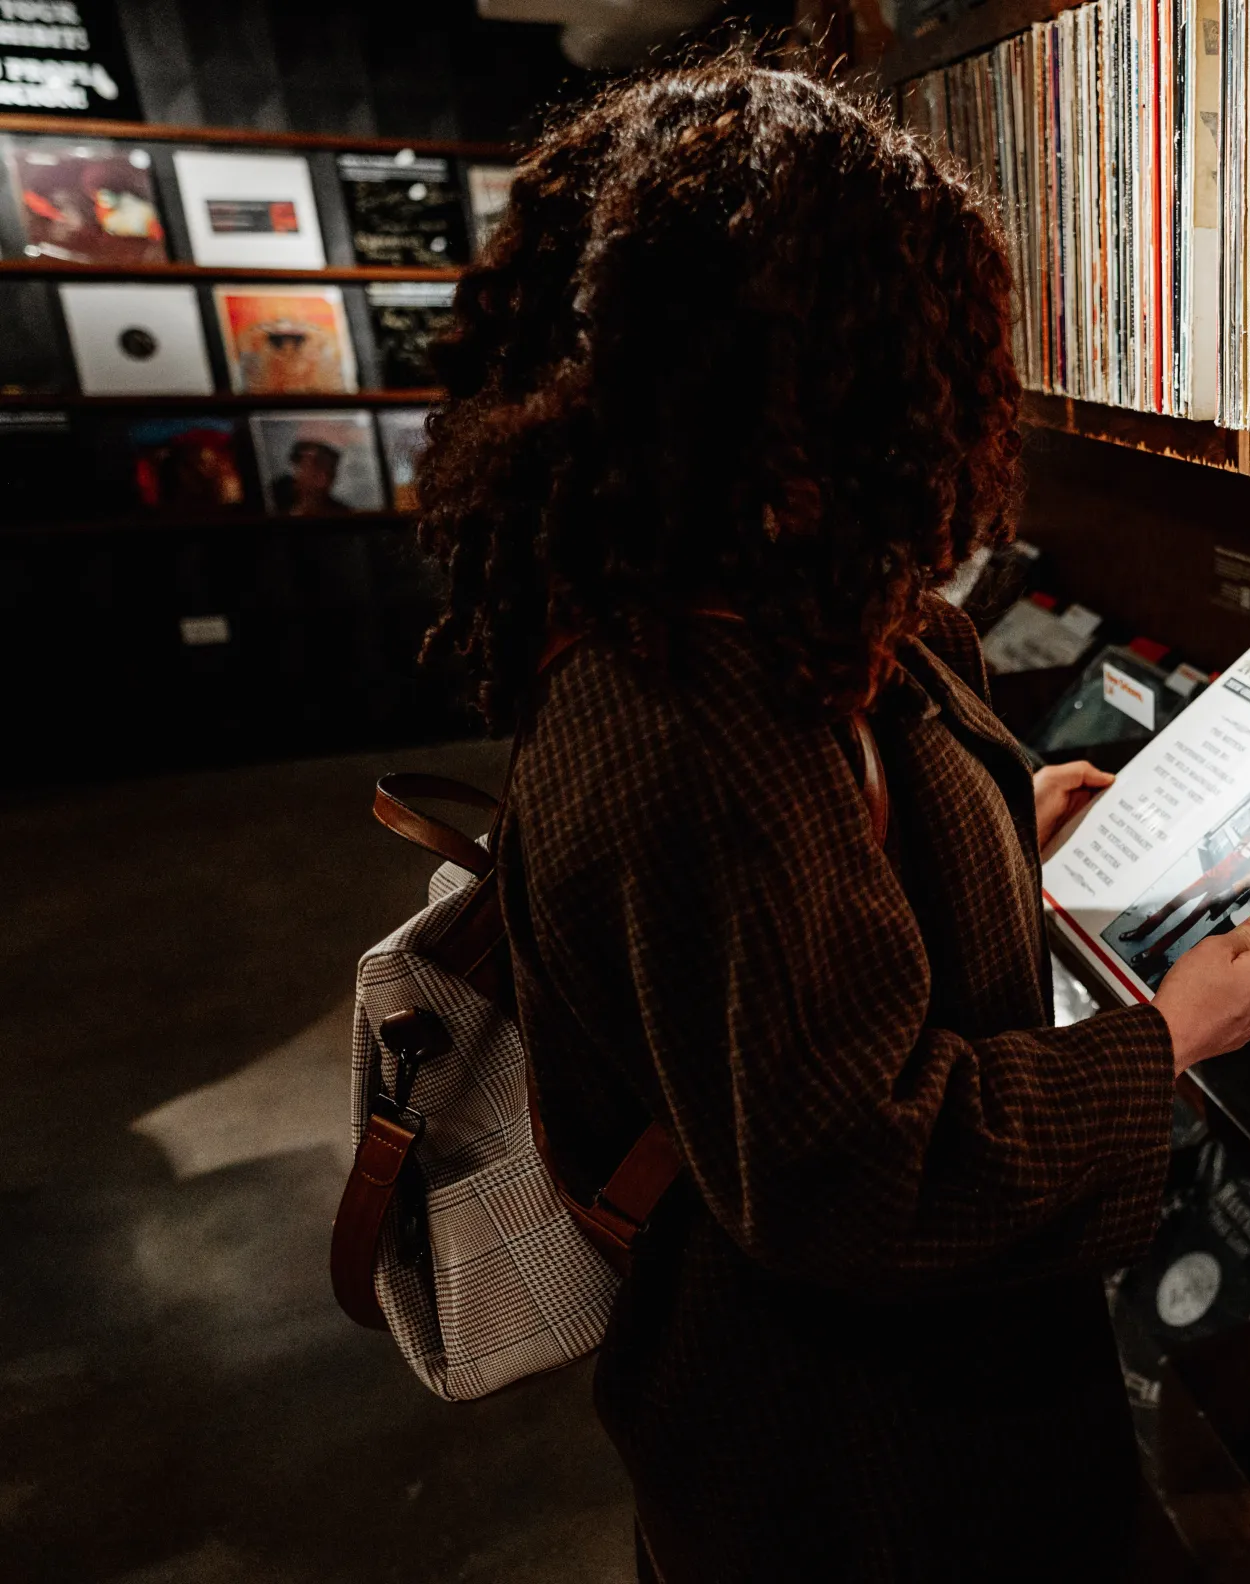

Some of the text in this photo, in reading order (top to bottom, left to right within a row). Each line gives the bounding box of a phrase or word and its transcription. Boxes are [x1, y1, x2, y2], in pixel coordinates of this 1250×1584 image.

[1225, 678, 1244, 692] NEW
[1173, 759, 1191, 774] WILD
[1096, 823, 1109, 836] THE
[1089, 839, 1102, 852] THE
[1072, 846, 1085, 859] AND
[1082, 855, 1098, 872] MANY
